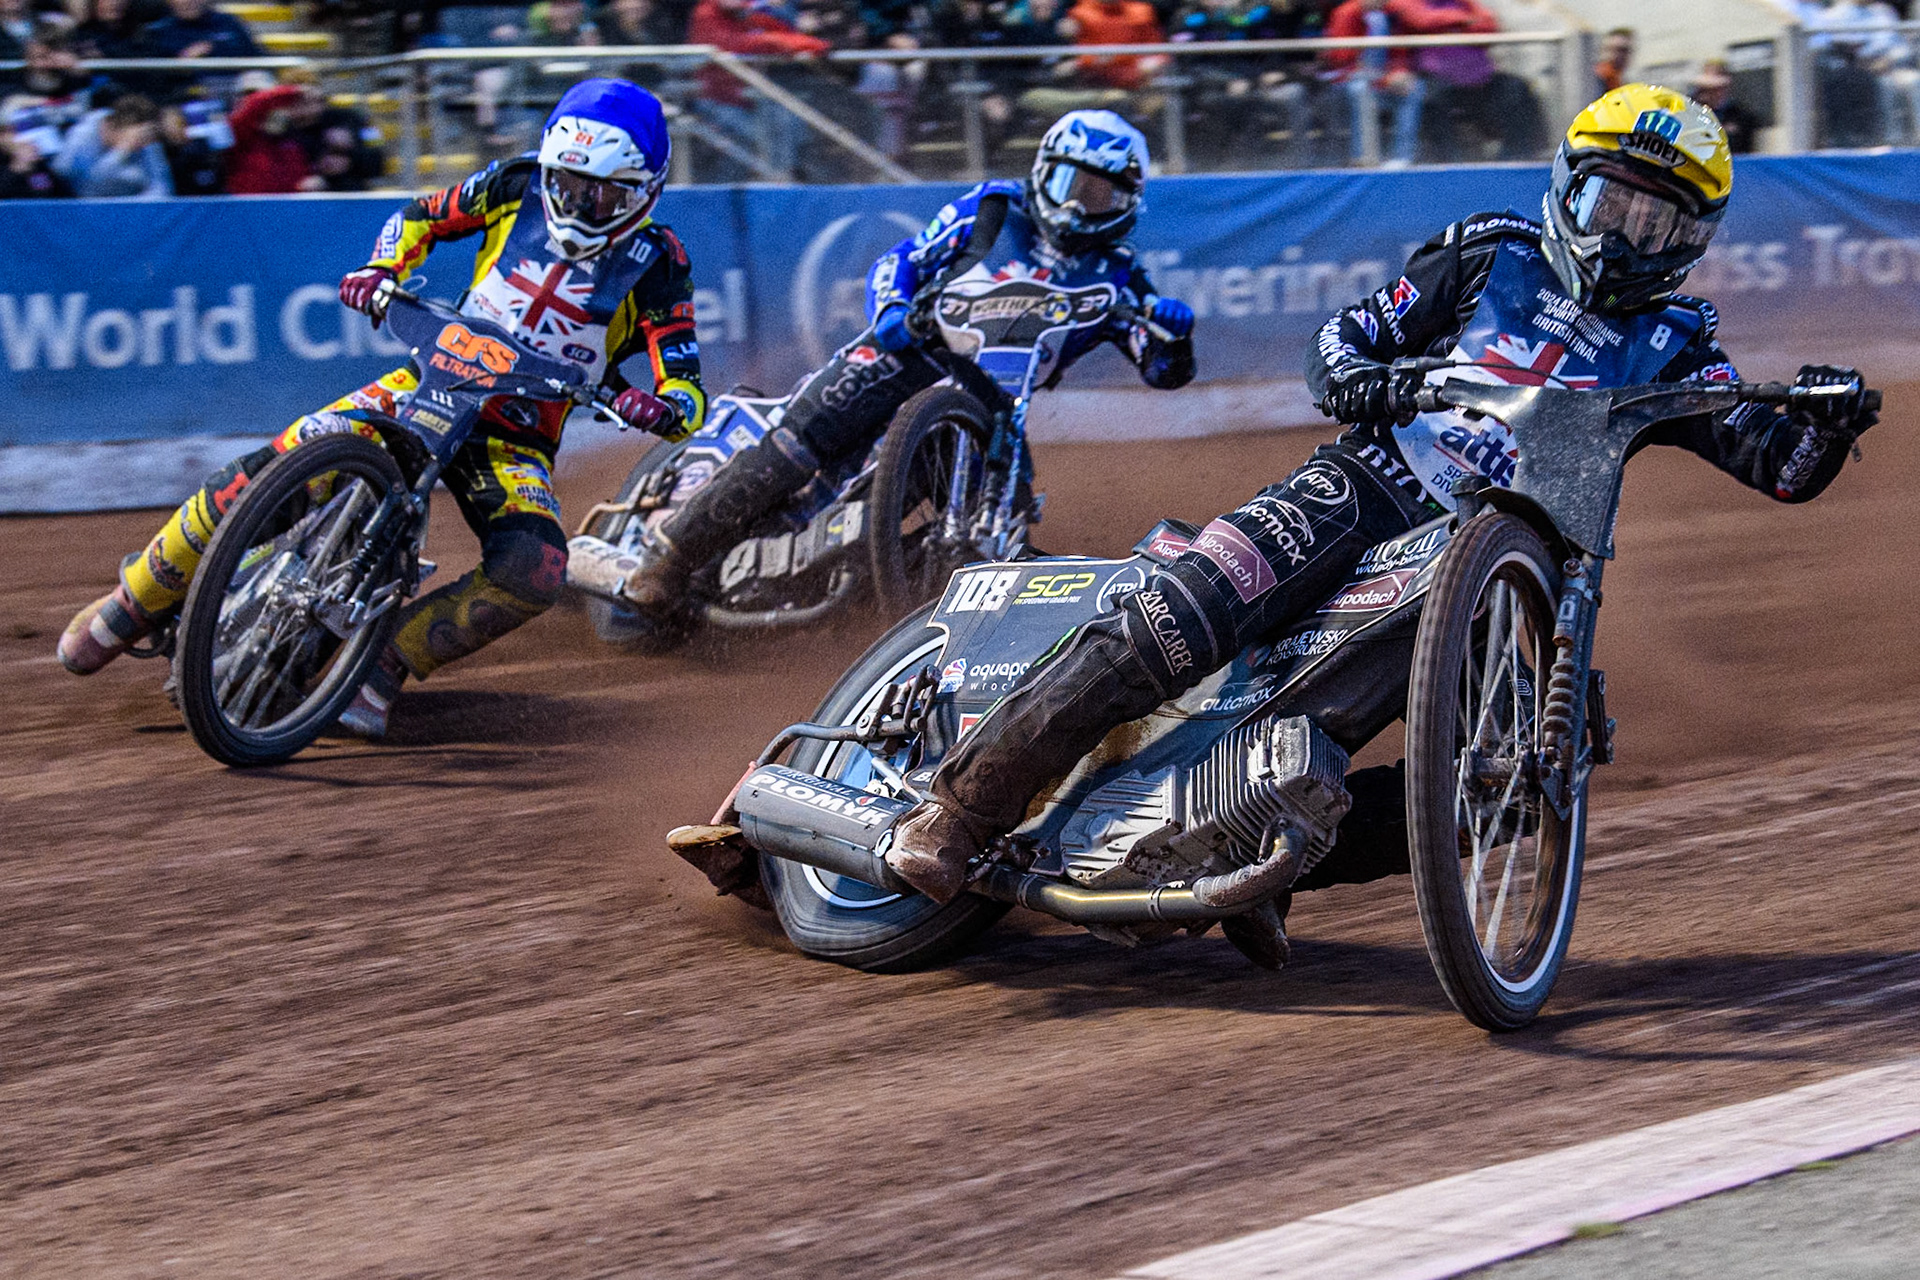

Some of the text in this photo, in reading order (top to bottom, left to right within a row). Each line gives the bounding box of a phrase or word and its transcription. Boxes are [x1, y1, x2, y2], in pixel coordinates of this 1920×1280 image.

[627, 238, 652, 264] 10
[0, 284, 255, 371] World
[1532, 313, 1599, 364] BRITISH FINAL
[1649, 322, 1672, 351] 8
[434, 322, 520, 375] CFS
[1198, 534, 1254, 589] Alpodach
[945, 570, 1021, 613] 108
[1018, 573, 1096, 598] SGP
[1272, 629, 1348, 654] KRAJEWSKI
[1200, 685, 1275, 711] automax
[750, 774, 893, 826] PLOMYK
[777, 768, 854, 797] ORIGINAL
